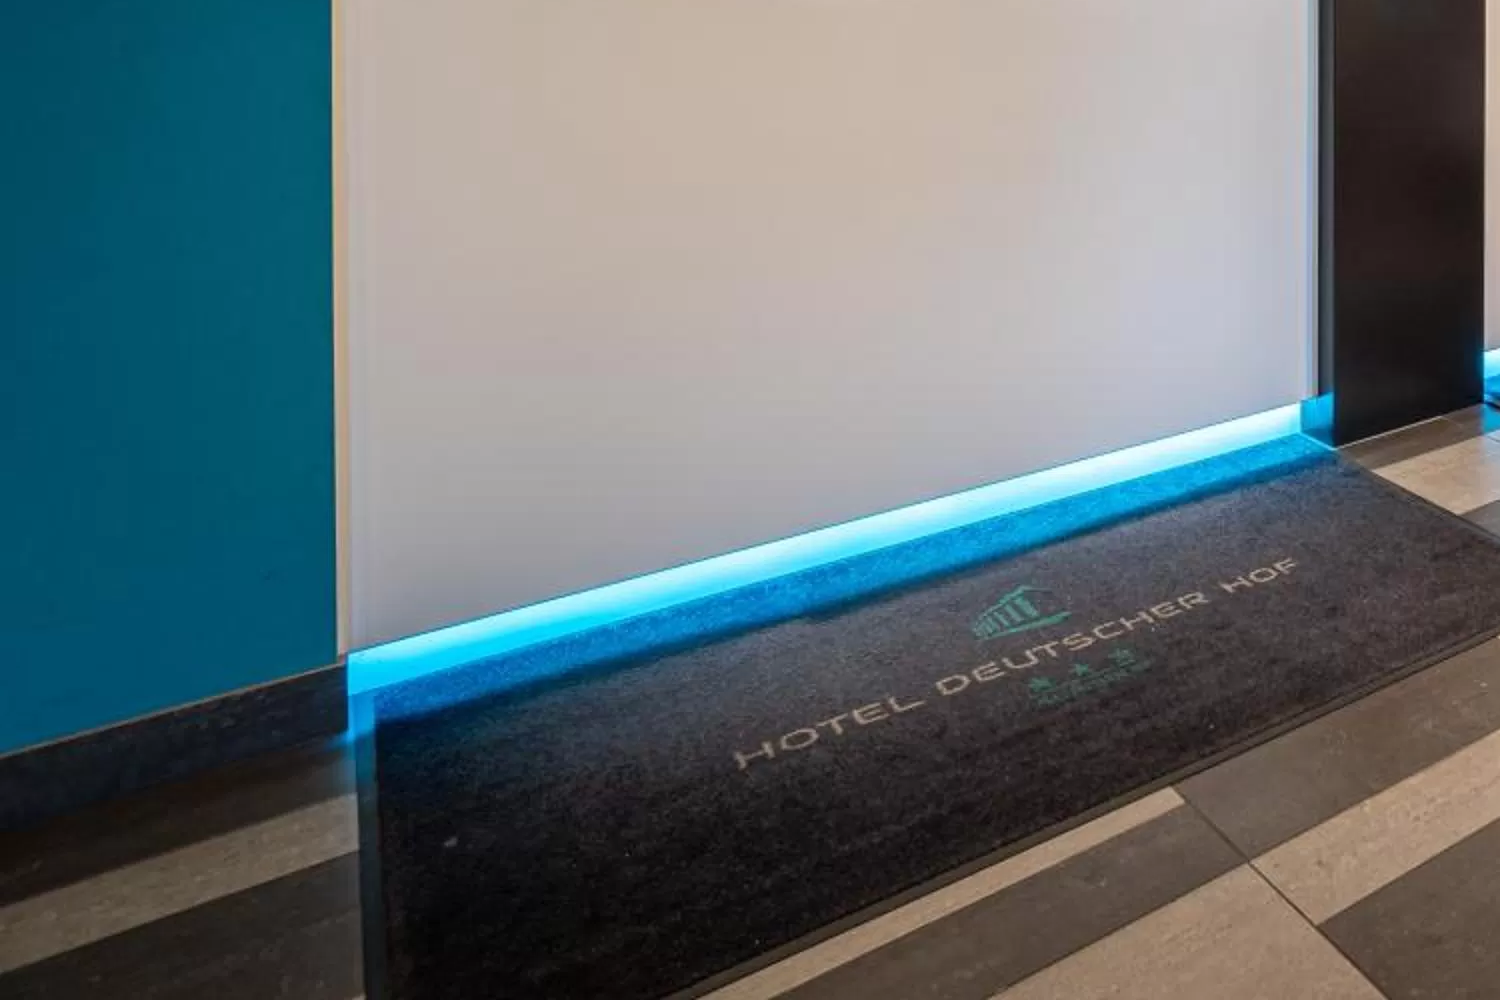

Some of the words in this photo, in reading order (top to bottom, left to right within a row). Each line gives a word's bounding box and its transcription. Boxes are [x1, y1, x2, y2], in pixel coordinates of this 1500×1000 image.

[731, 693, 925, 771] HOTEL
[934, 589, 1212, 697] DEUTSCHER
[1218, 556, 1299, 595] HOF
